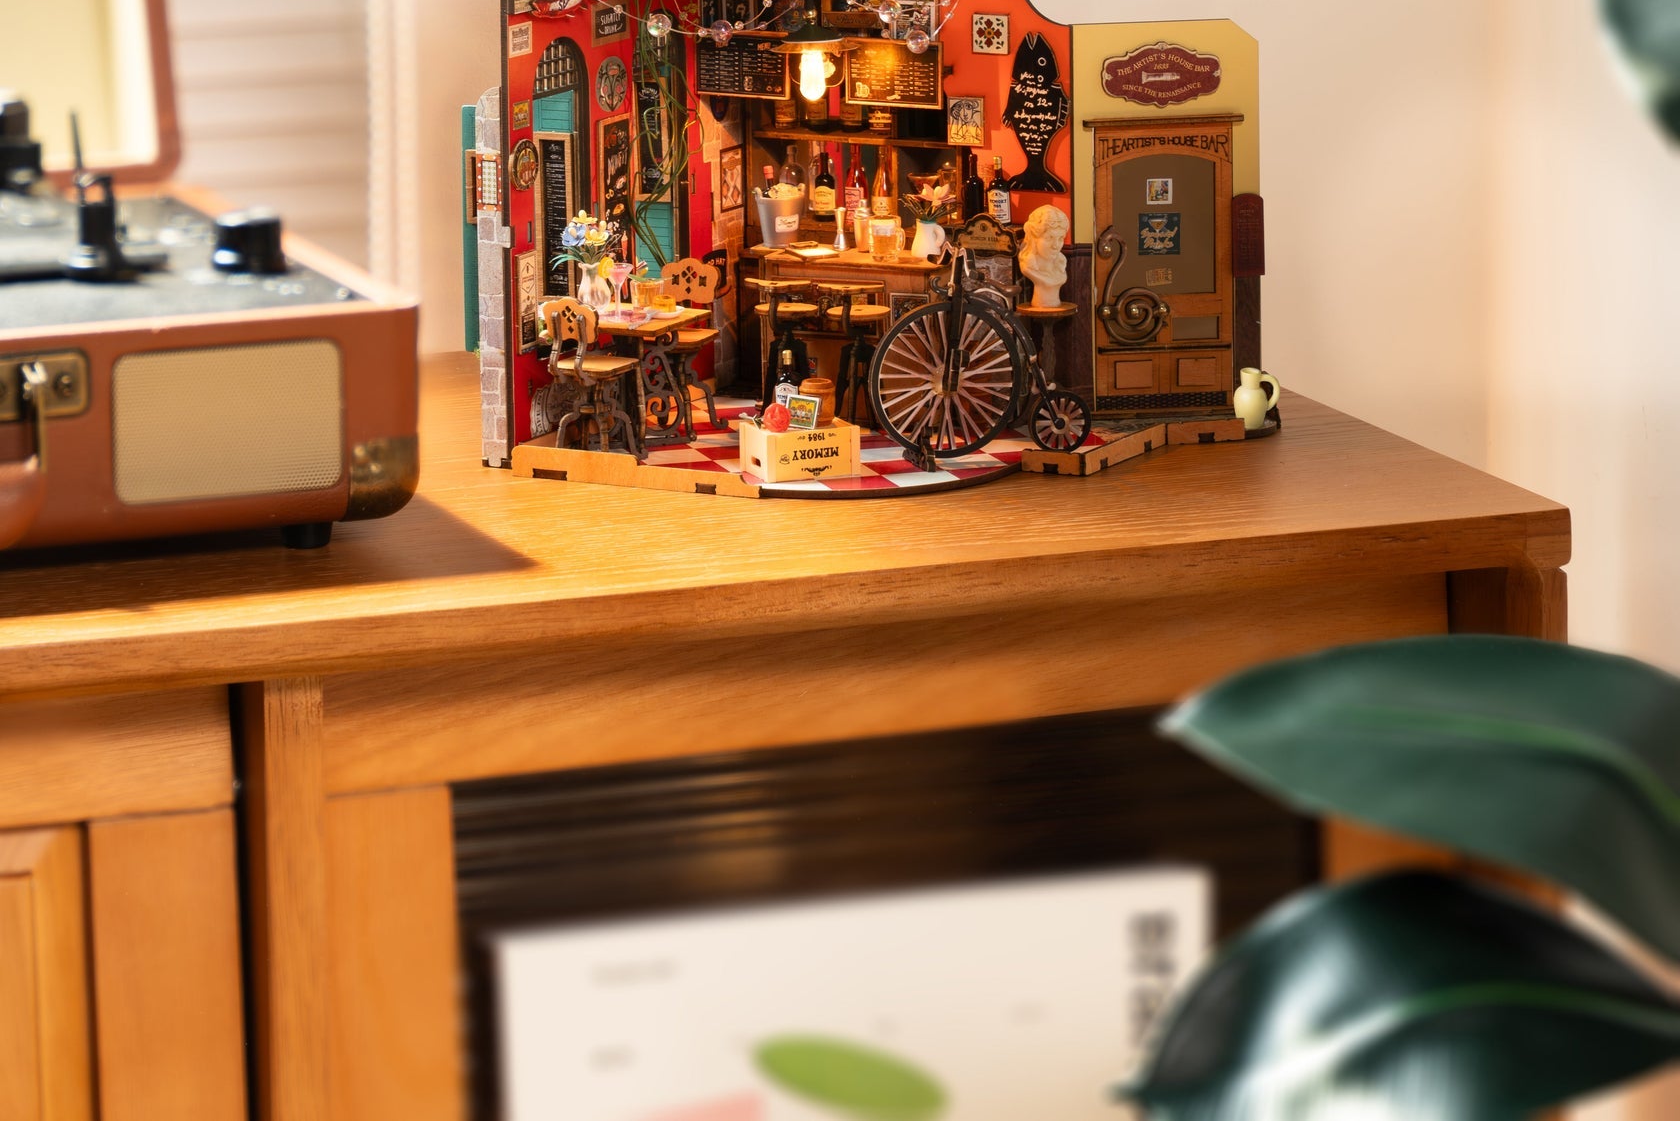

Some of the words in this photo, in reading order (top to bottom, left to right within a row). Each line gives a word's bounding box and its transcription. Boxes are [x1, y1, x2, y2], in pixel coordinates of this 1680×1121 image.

[1117, 66, 1132, 76] THE
[1133, 53, 1166, 70] ARTIST'S
[1168, 53, 1194, 70] HOUSE
[1194, 64, 1210, 72] BAR
[1122, 84, 1143, 93] SINCE
[1144, 87, 1157, 97] THE
[1157, 82, 1202, 98] RENAISSANCE
[1167, 135, 1199, 148] HOUSE
[1200, 134, 1230, 158] BAR
[808, 432, 825, 442] 1984
[792, 446, 839, 461] MEMORY
